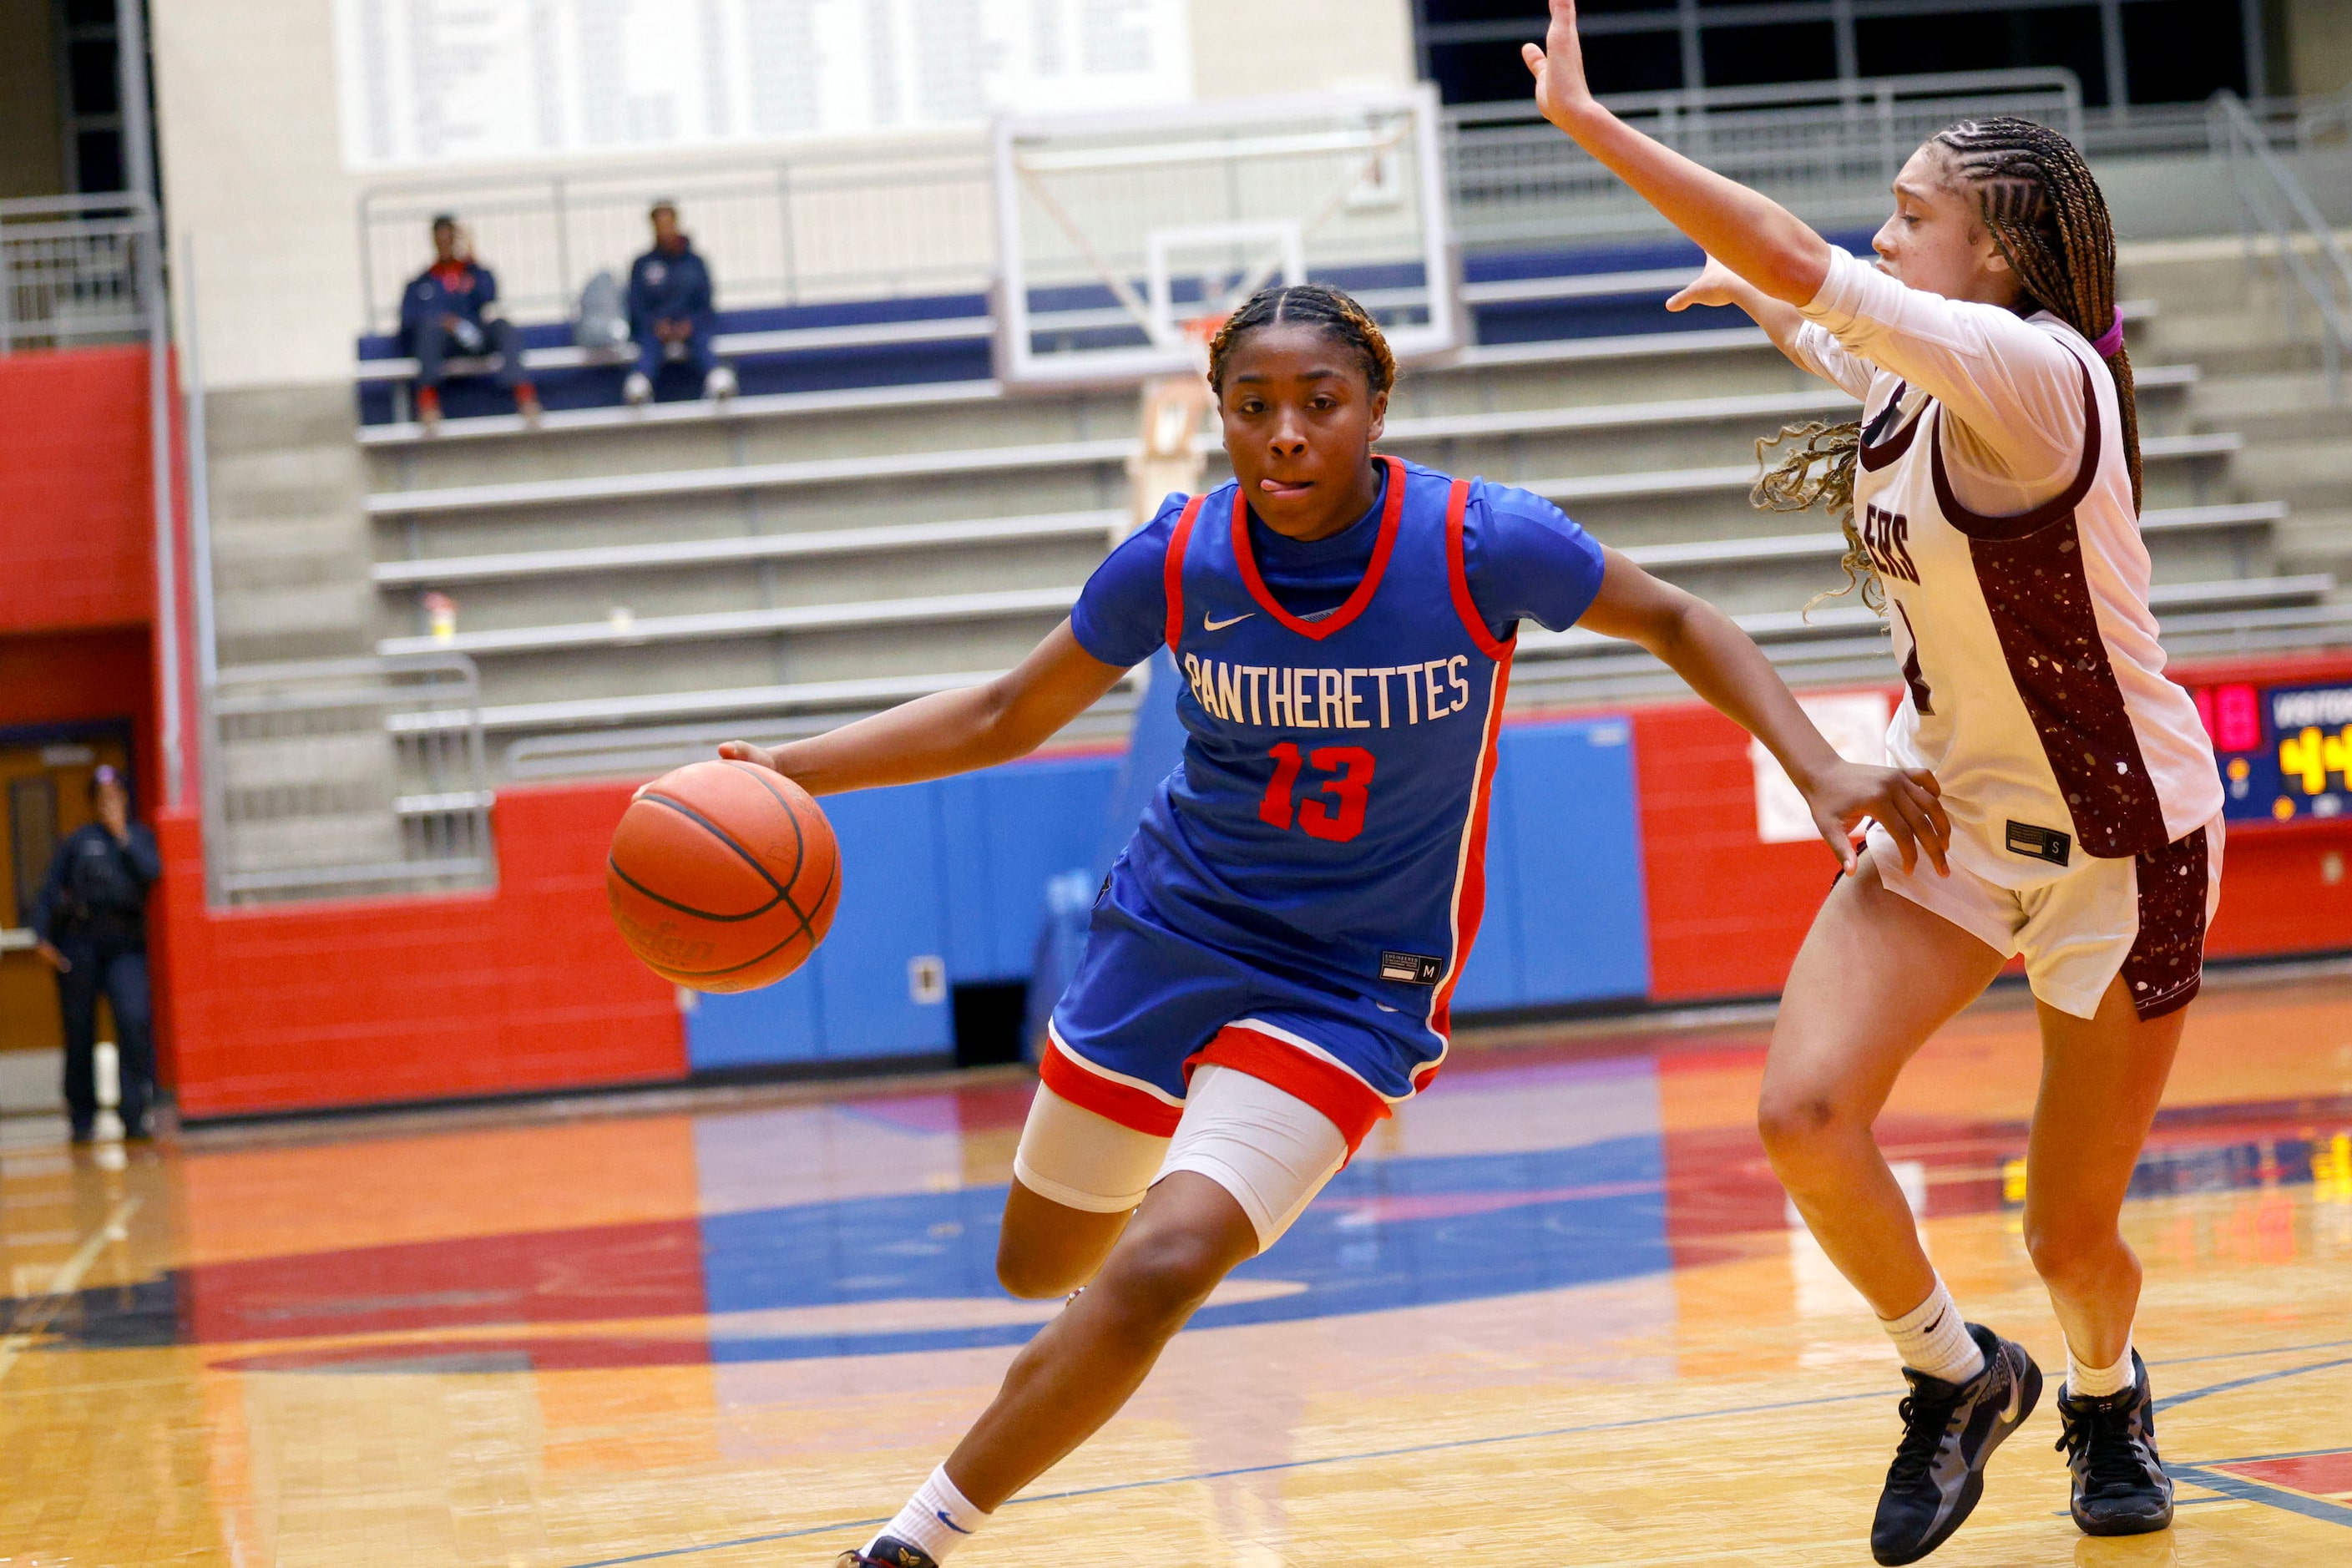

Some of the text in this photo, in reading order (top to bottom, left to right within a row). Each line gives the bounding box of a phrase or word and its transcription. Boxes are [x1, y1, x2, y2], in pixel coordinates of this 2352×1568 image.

[1864, 503, 1920, 586] ERS
[1184, 652, 1469, 729] PANTHERETTES
[1258, 741, 1376, 842] 13
[2051, 841, 2060, 854] S
[1423, 964, 1435, 978] M
